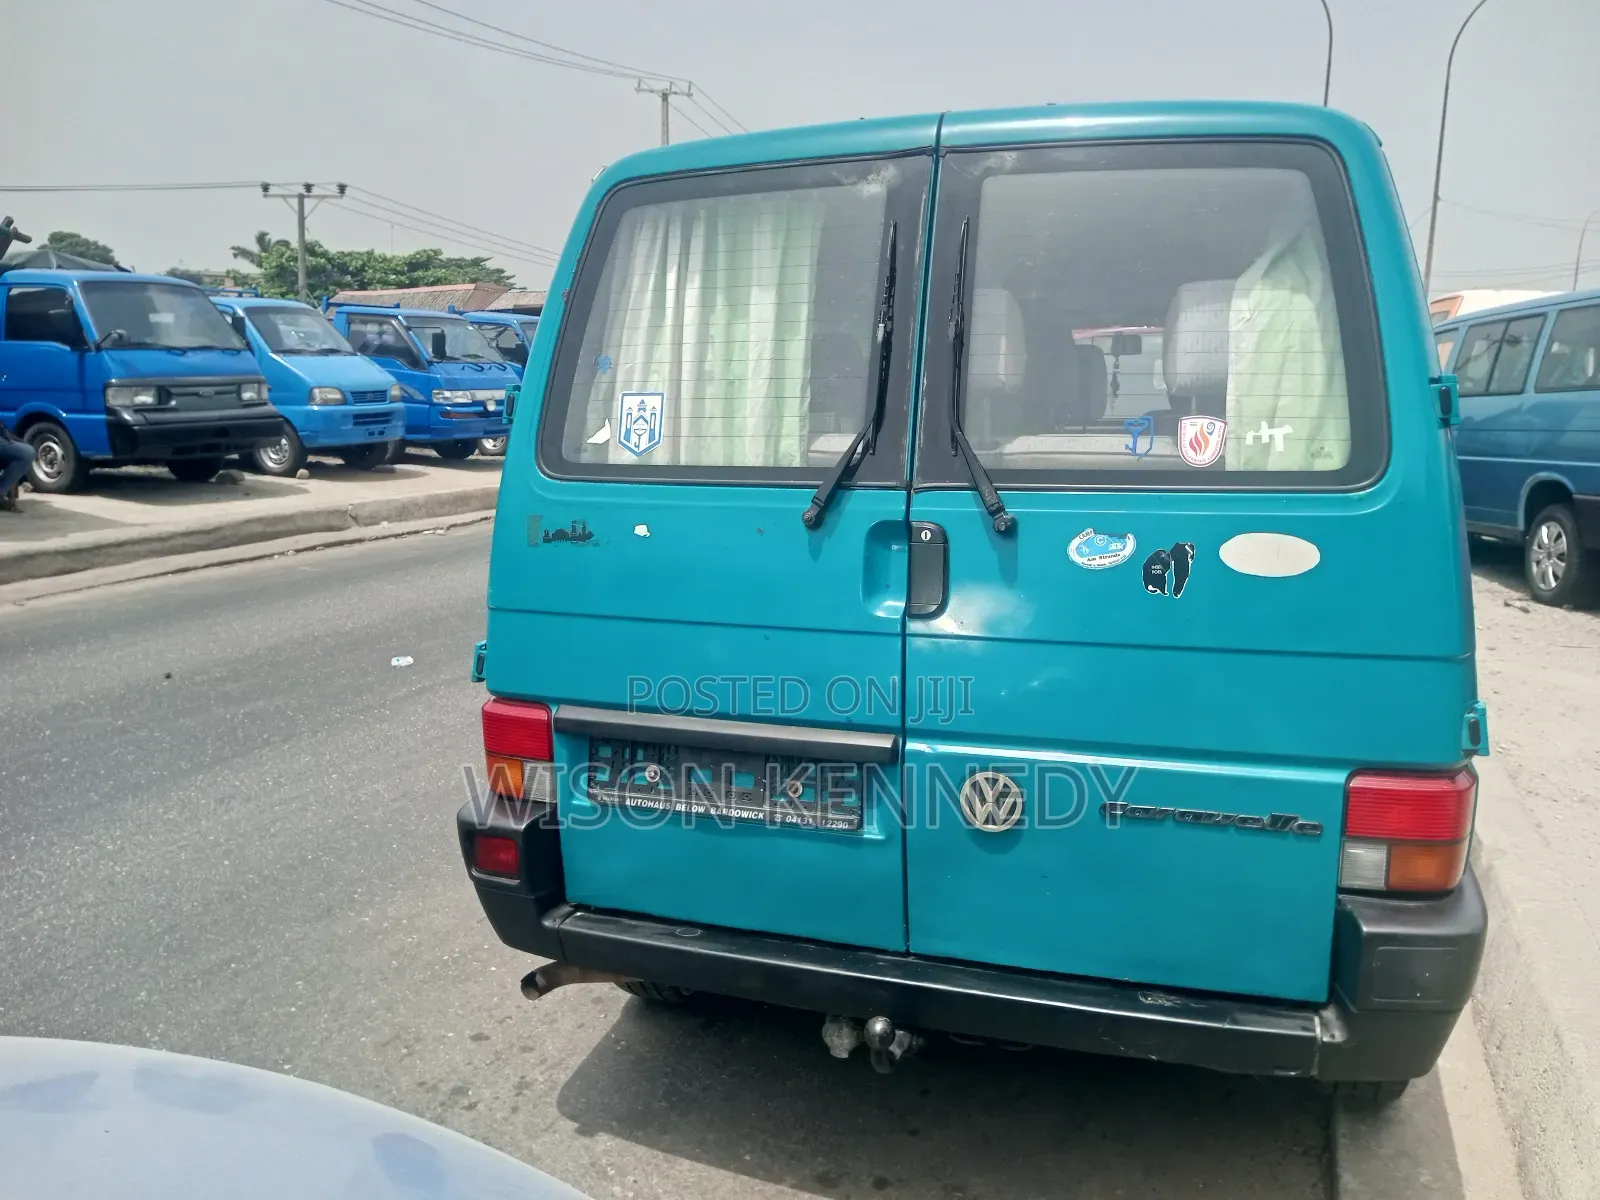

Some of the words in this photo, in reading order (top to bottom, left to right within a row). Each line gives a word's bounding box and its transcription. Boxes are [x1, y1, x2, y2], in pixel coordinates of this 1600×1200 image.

[625, 797, 671, 810] AUTOHAUS
[676, 802, 706, 814] BELOW
[710, 806, 765, 820] BARDOWICK
[961, 772, 1023, 832] VW
[1100, 801, 1323, 836] Caravelle
